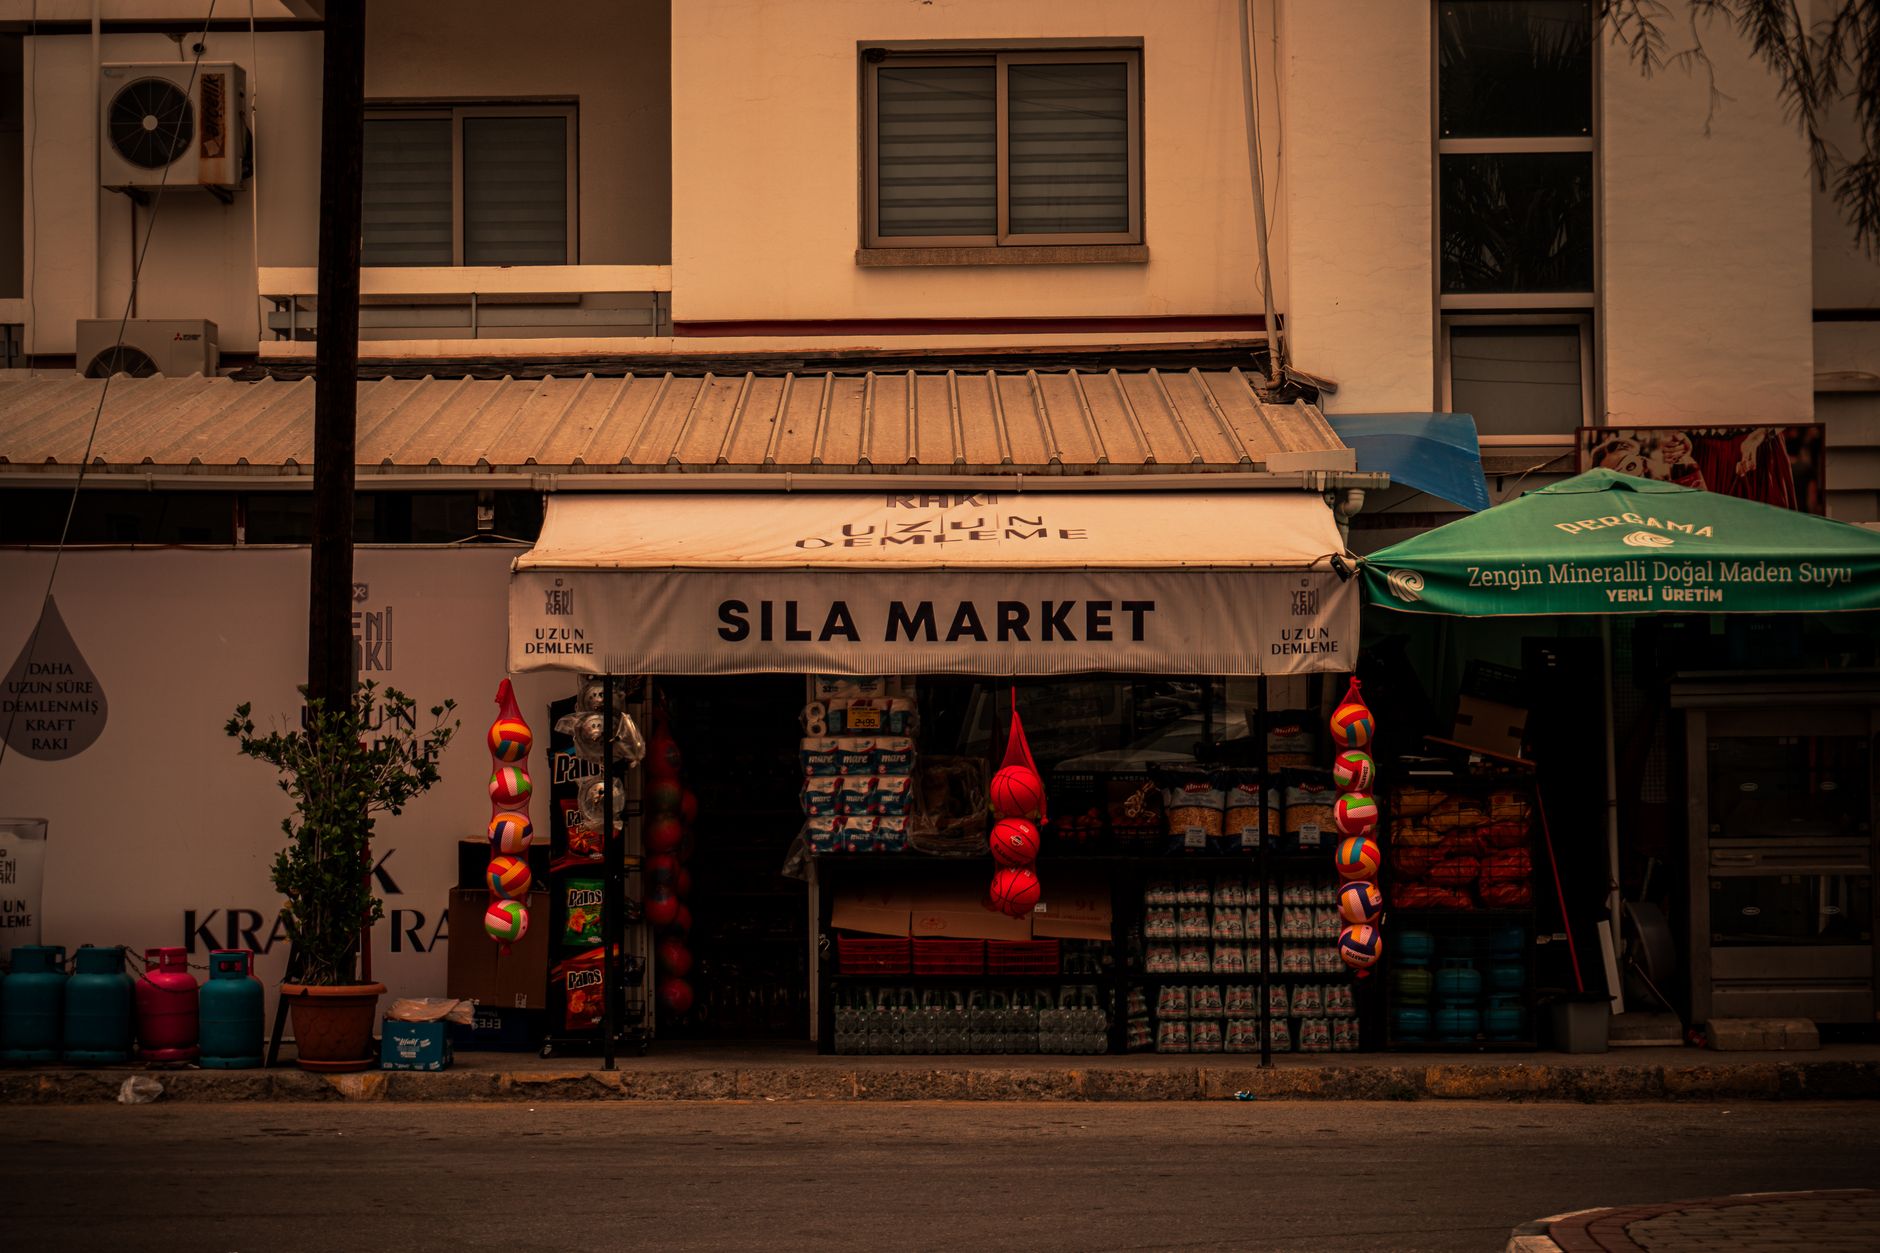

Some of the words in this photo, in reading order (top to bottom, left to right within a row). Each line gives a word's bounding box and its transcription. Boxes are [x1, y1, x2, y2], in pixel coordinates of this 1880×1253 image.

[842, 515, 1043, 537] UZUN
[1554, 512, 1714, 538] PERGAMA
[795, 527, 1088, 549] DEMLEME
[1467, 564, 1543, 591] Zengin
[1548, 561, 1648, 584] Mineralli
[1654, 560, 1715, 587] Doğal
[1720, 561, 1793, 582] Maden
[1799, 562, 1853, 588] Suyu
[545, 588, 574, 603] YENİ
[1606, 585, 1654, 603] YERLİ
[1662, 585, 1724, 603] ÜRETİM
[351, 606, 393, 641] ENİ
[717, 600, 861, 642] SILA
[884, 600, 1155, 642] MARKET
[535, 627, 585, 640] UZUN
[1281, 627, 1329, 641] UZUN
[525, 642, 594, 655] DEMLEME
[1271, 641, 1340, 655] DEMLEME
[30, 663, 73, 675] DAHA
[8, 681, 52, 693] UZUN
[56, 680, 93, 693] SÜRE
[3, 699, 99, 715] DEMLENMİŞ
[26, 719, 75, 731] KRAFT
[32, 738, 68, 750] RAKI
[391, 909, 450, 952] RA
